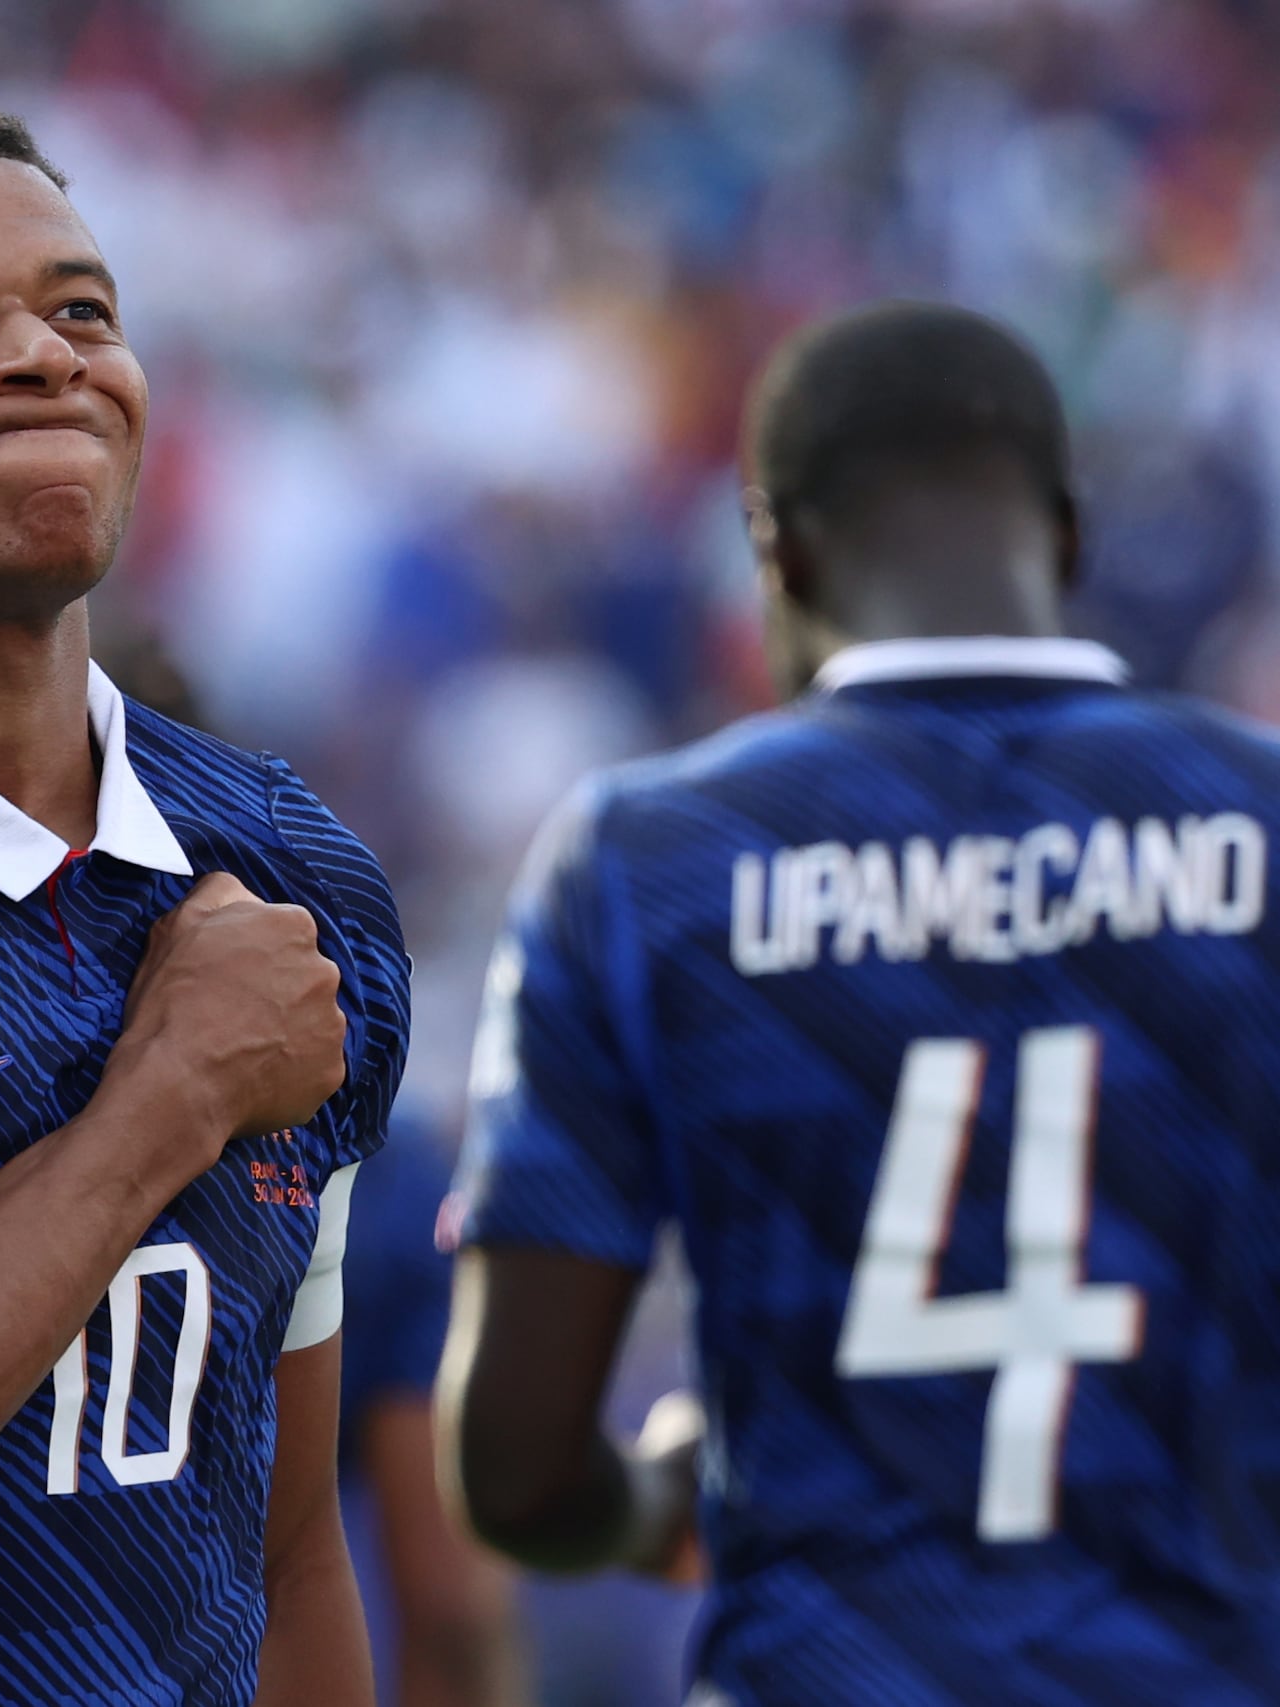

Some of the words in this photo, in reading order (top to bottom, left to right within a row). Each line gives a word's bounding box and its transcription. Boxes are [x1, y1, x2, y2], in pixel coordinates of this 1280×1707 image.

[730, 812, 1266, 976] UPAMECANO
[46, 1242, 212, 1496] 10
[834, 1024, 1146, 1541] 4
